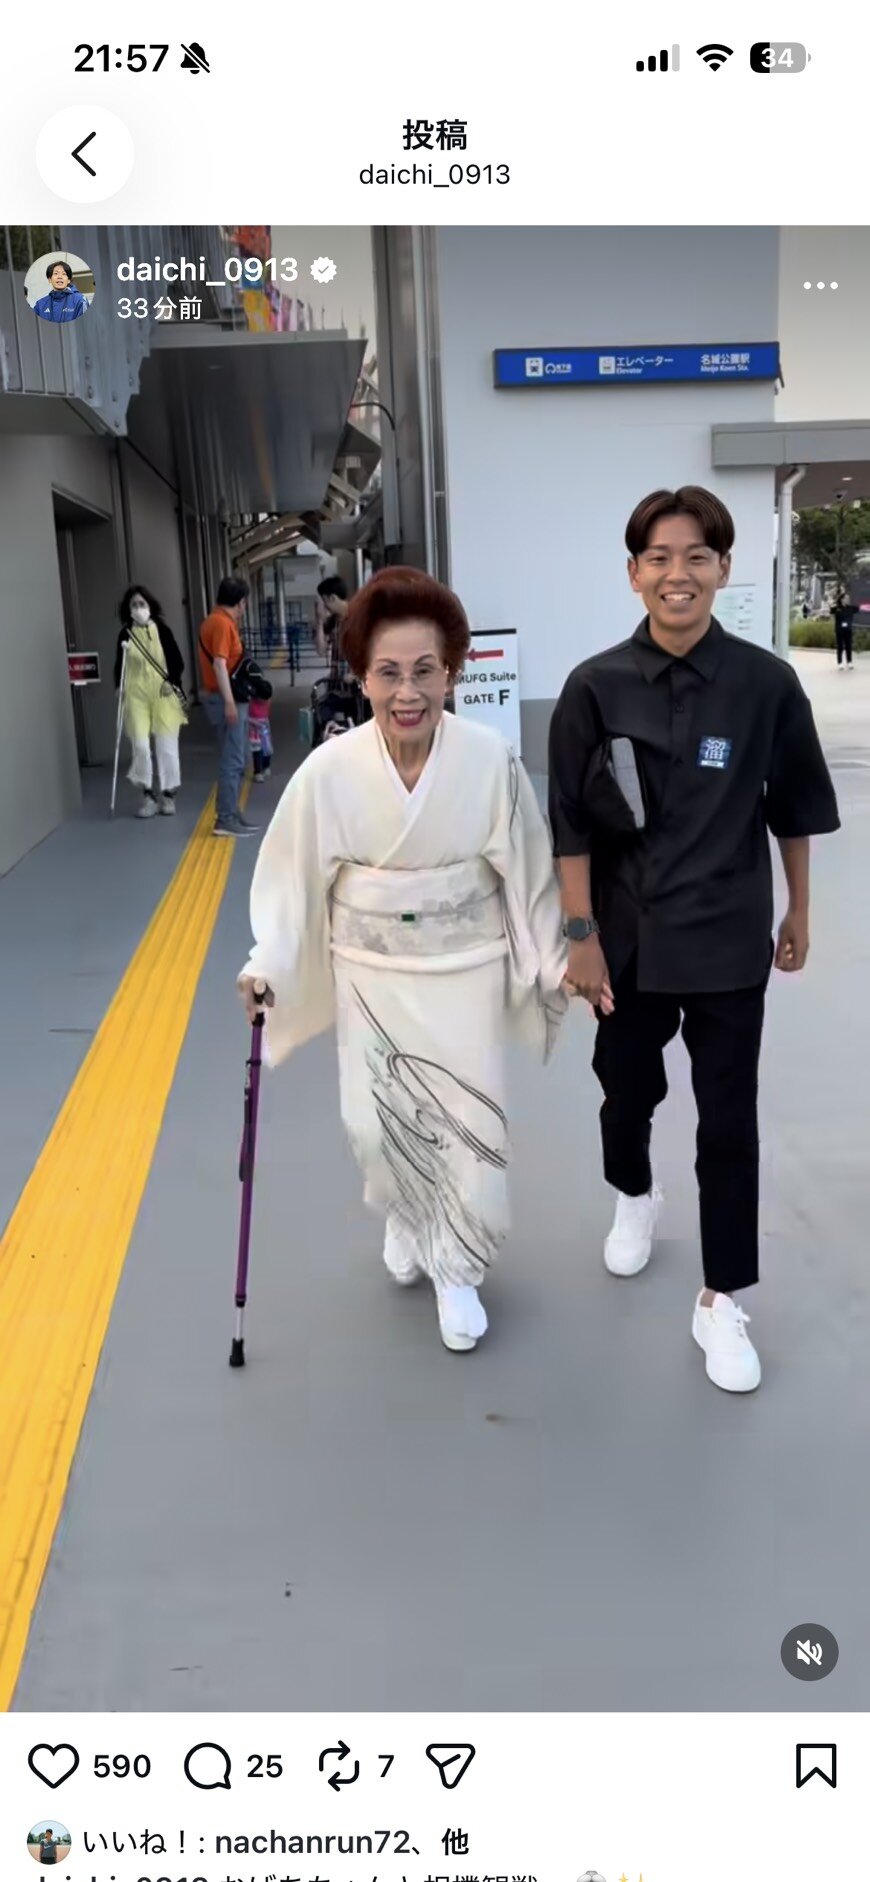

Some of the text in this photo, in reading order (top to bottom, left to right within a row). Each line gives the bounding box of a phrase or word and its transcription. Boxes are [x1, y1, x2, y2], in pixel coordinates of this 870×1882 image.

[616, 356, 674, 366] エレベーター
[490, 672, 517, 682] Suite
[463, 688, 510, 706] GATE F
